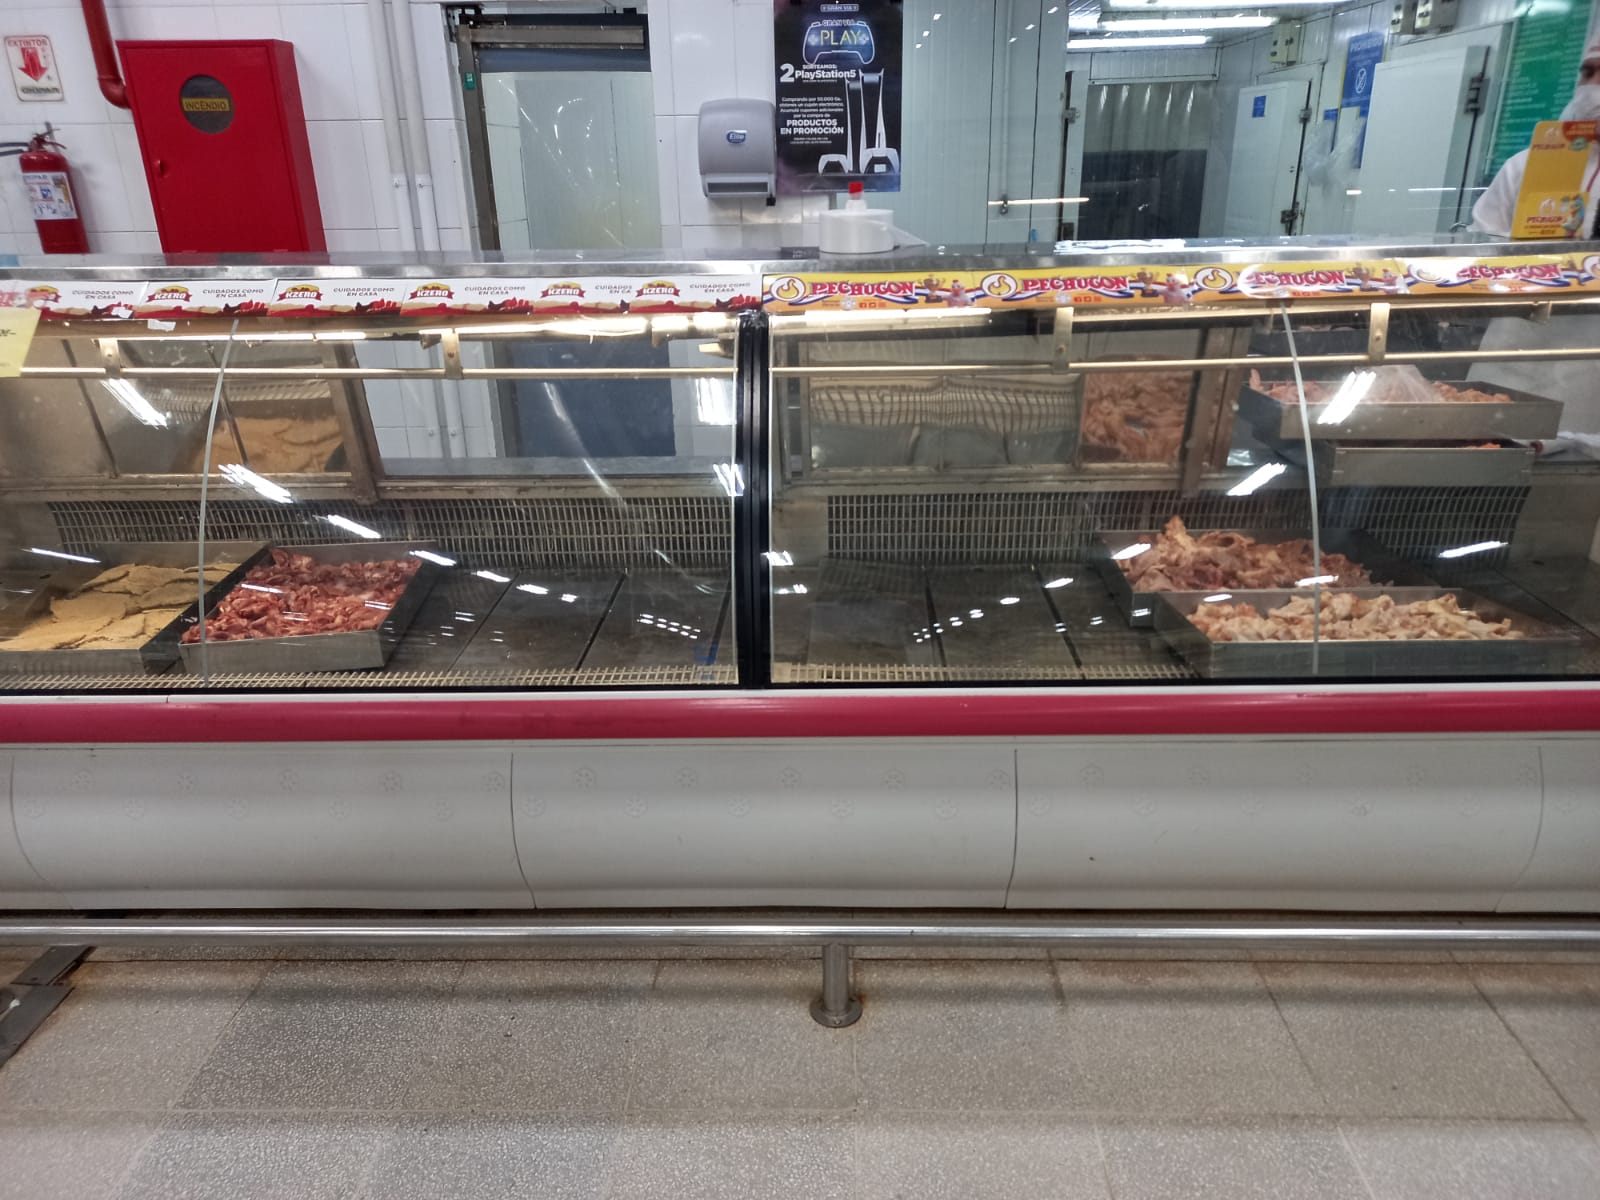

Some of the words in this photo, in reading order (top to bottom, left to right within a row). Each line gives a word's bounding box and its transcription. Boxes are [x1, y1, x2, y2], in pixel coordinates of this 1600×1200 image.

[820, 30, 861, 45] PLAY
[780, 63, 795, 83] 2
[795, 69, 856, 80] PlayStation5
[786, 119, 838, 127] PRODUCTOS
[793, 126, 844, 134] PROMOCIÓN
[811, 281, 915, 295] PECHUGON
[1022, 276, 1128, 291] PECHUGON
